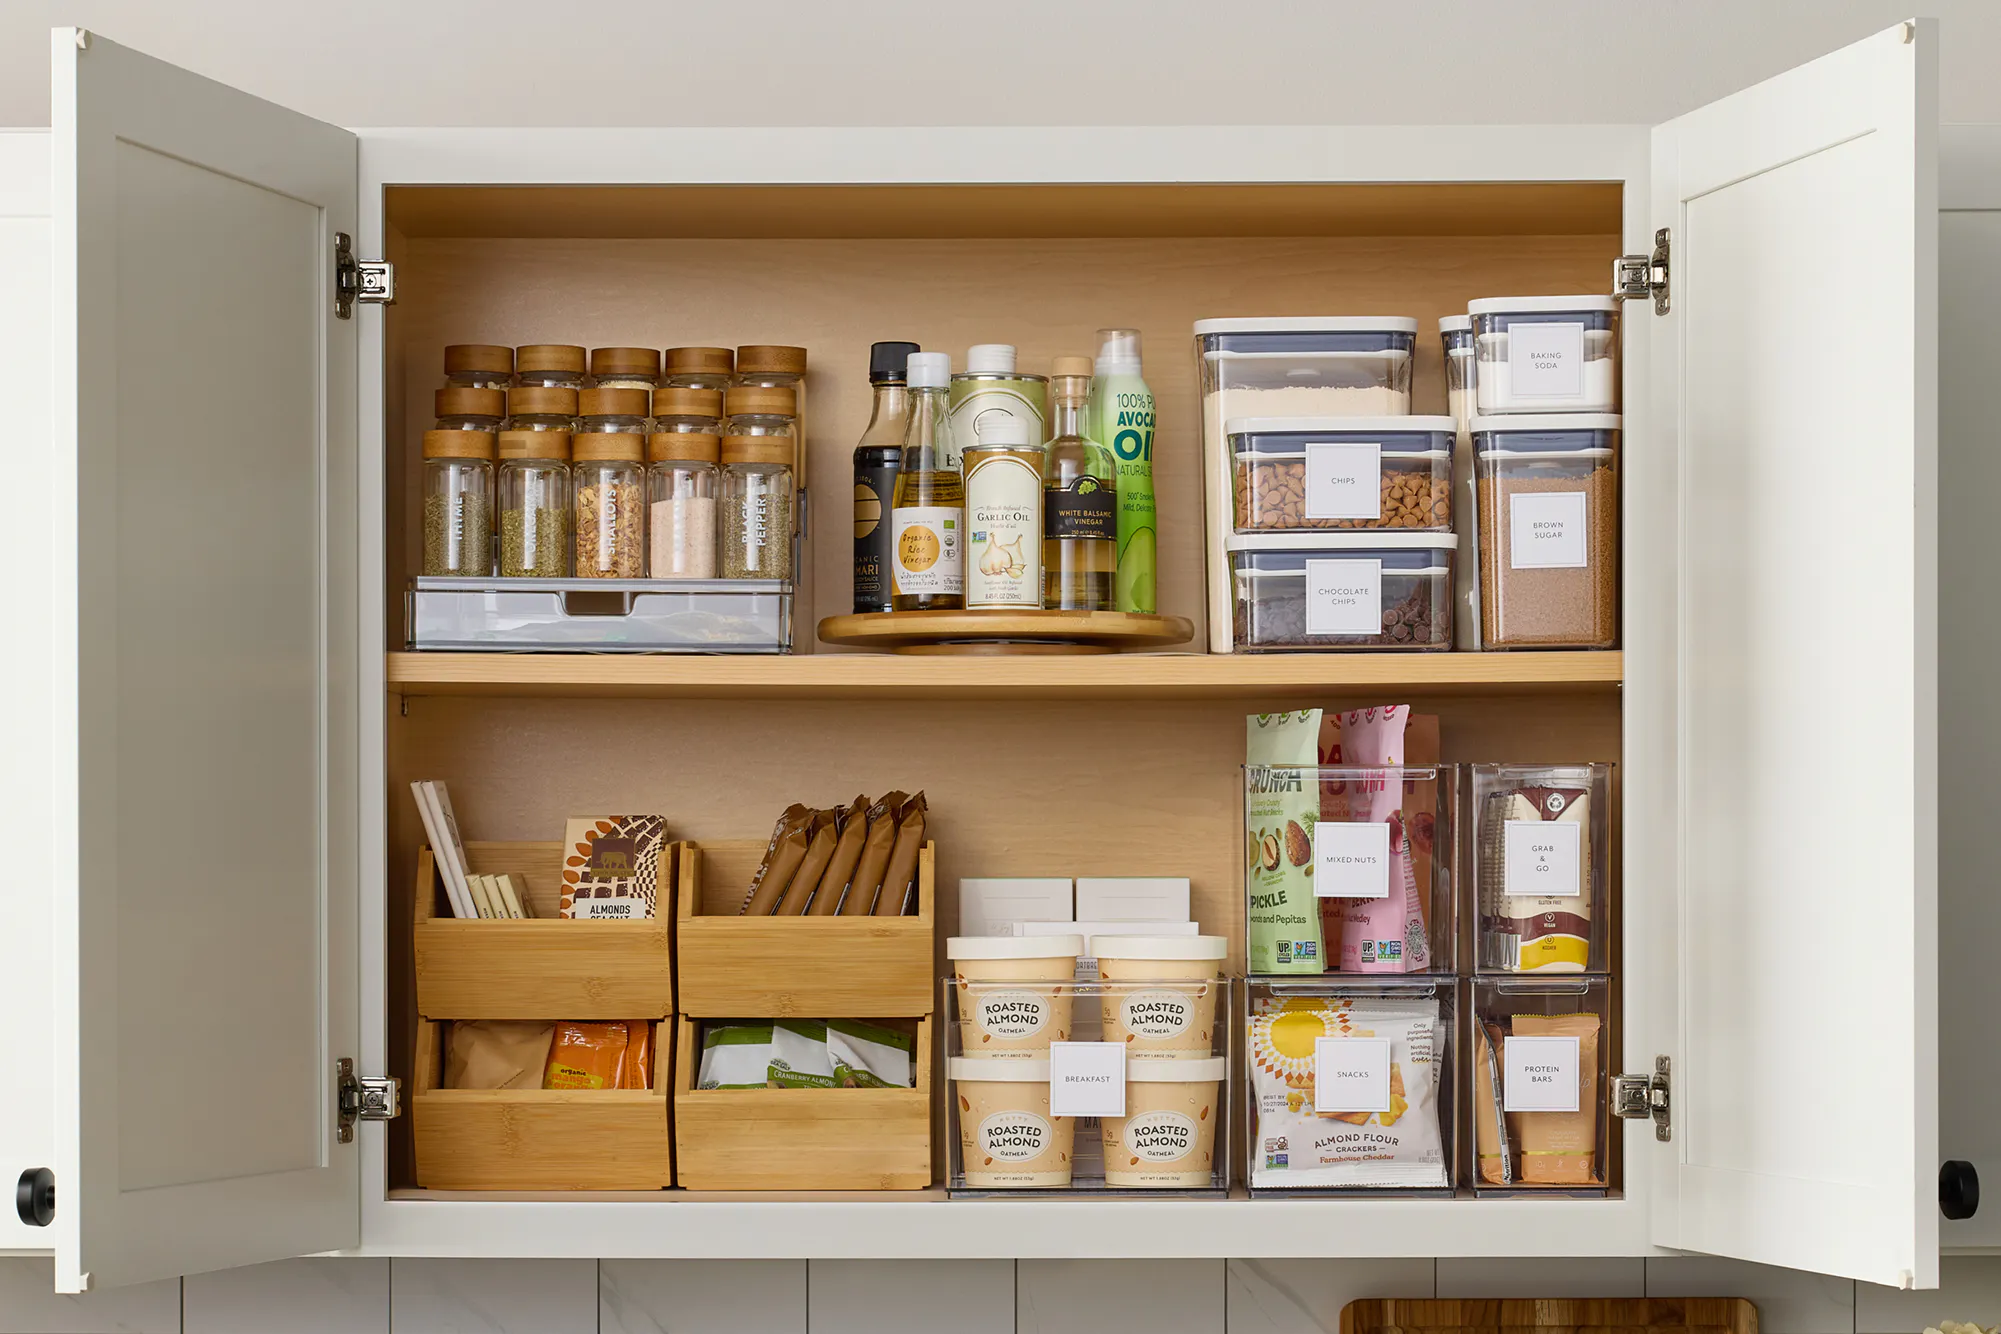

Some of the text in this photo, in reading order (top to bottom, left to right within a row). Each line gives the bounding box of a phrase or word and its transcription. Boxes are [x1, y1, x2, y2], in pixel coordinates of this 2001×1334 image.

[1530, 352, 1562, 360] BAKING
[1534, 362, 1558, 370] SODA
[1116, 393, 1146, 409] 100%
[1331, 477, 1356, 485] CHIPS
[453, 497, 463, 540] THYME
[977, 511, 1030, 521] GARLIC OIL
[1058, 509, 1112, 518] WHITE BALSAMIC
[606, 490, 617, 554] SHALLOTS
[756, 499, 767, 546] PEPPER
[1074, 518, 1104, 526] VINEGAR
[1533, 521, 1564, 529] BROWN
[902, 533, 932, 544] Organic
[1534, 531, 1563, 540] SUGAR
[907, 545, 926, 554] Rice
[903, 555, 932, 565] Vinegar
[1326, 856, 1377, 864] MIXED NUTS
[589, 904, 631, 915] ALMONDS
[1275, 914, 1307, 926] Pepitas
[985, 1002, 1040, 1014] ROASTED
[1129, 1002, 1185, 1014] ROASTED
[986, 1014, 1039, 1026] ALMOND
[1131, 1014, 1183, 1026] ALMOND
[560, 1067, 587, 1076] organic
[1524, 1065, 1560, 1073] PROTEIN
[551, 1073, 591, 1085] mango
[773, 1070, 811, 1082] CRANBERRY
[987, 1125, 1042, 1137] ROASTED
[1134, 1125, 1189, 1137] ROASTED
[989, 1137, 1041, 1149] ALMOND
[1135, 1137, 1187, 1149] ALMOND
[1314, 1133, 1400, 1149] ALMOND FLOUR
[1335, 1145, 1378, 1153] CRACKERS
[1319, 1153, 1395, 1164] Farmhouse Cheddar
